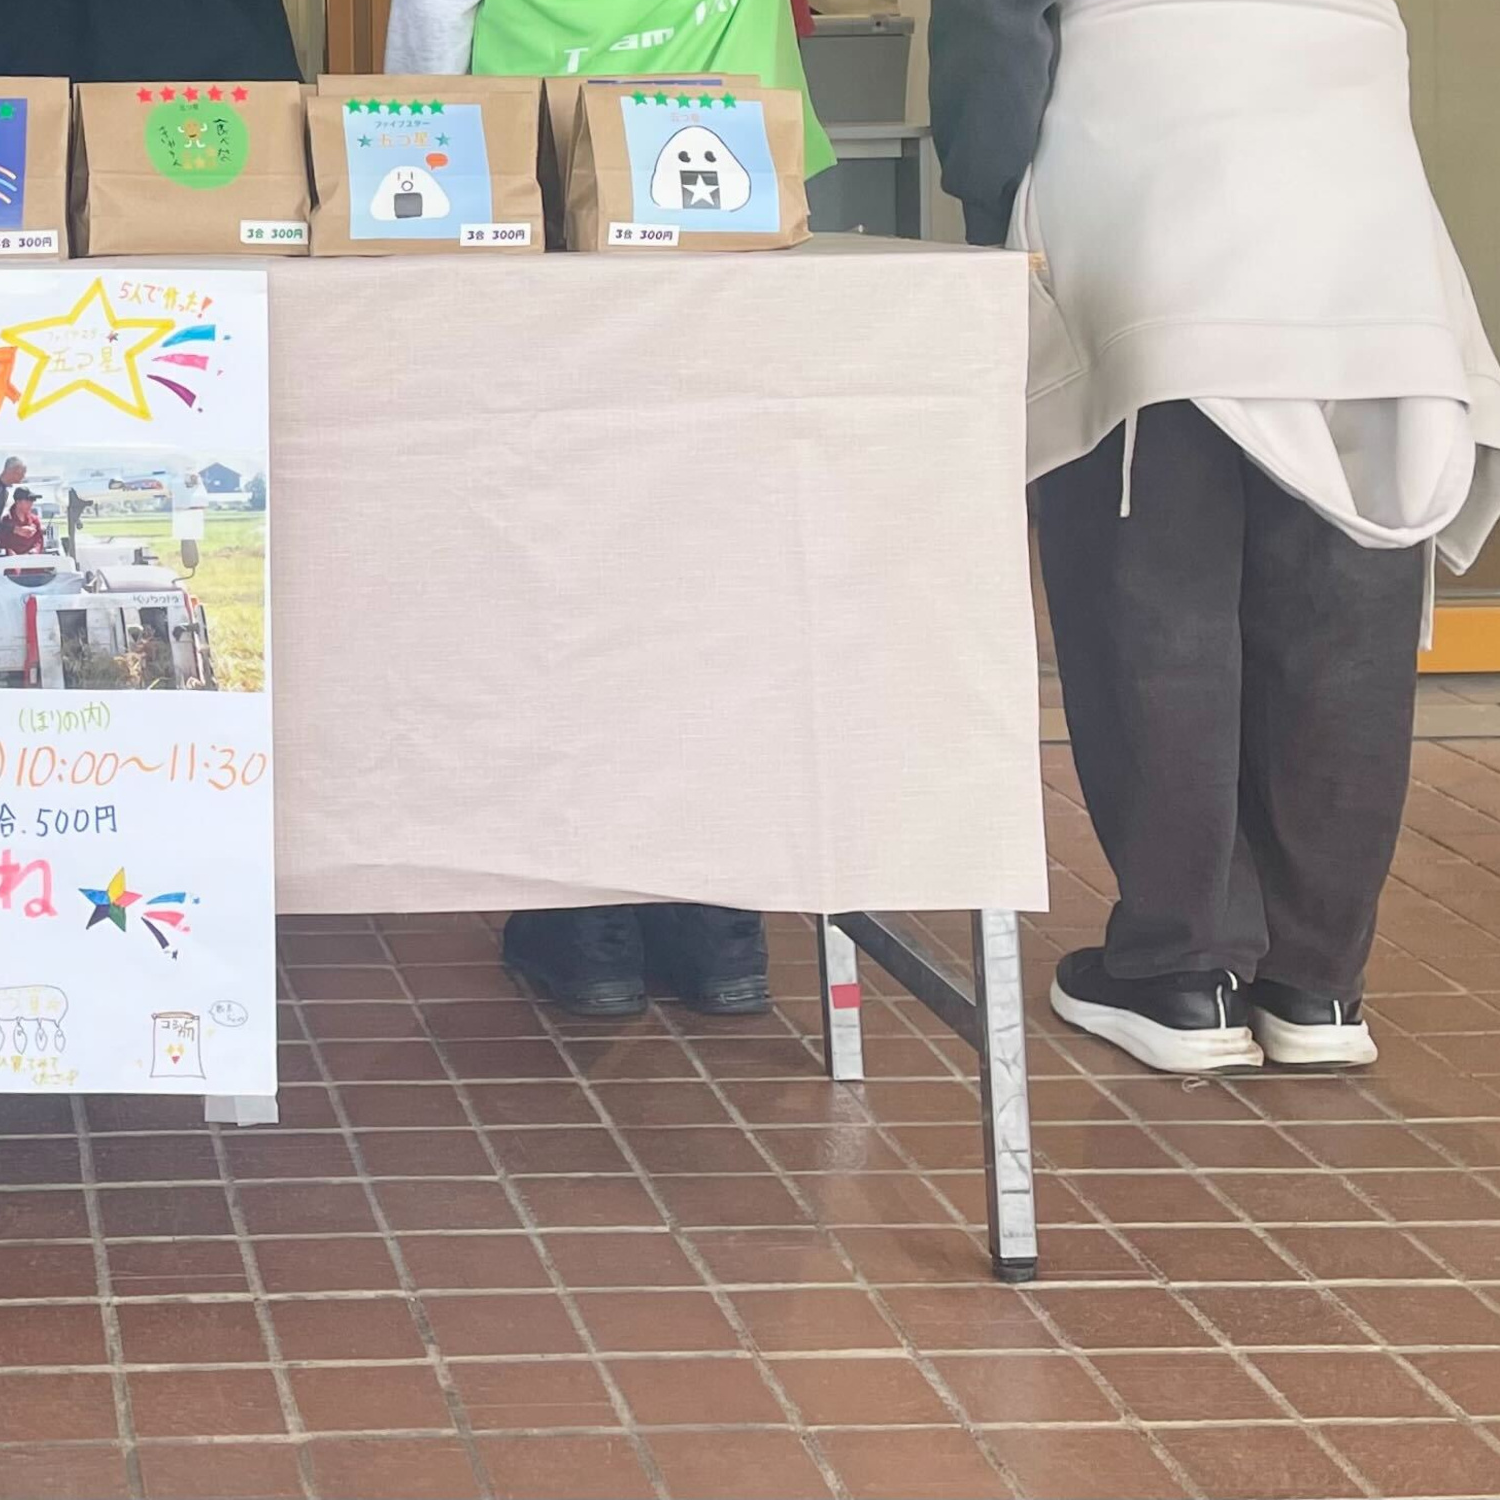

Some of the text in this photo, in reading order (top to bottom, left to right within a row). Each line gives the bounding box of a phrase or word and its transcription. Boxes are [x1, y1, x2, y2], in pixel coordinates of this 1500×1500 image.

[247, 229, 304, 240] 3合 300円
[467, 230, 526, 241] 3合 300円
[615, 229, 674, 241] 3合 300円
[18, 236, 53, 248] 300円
